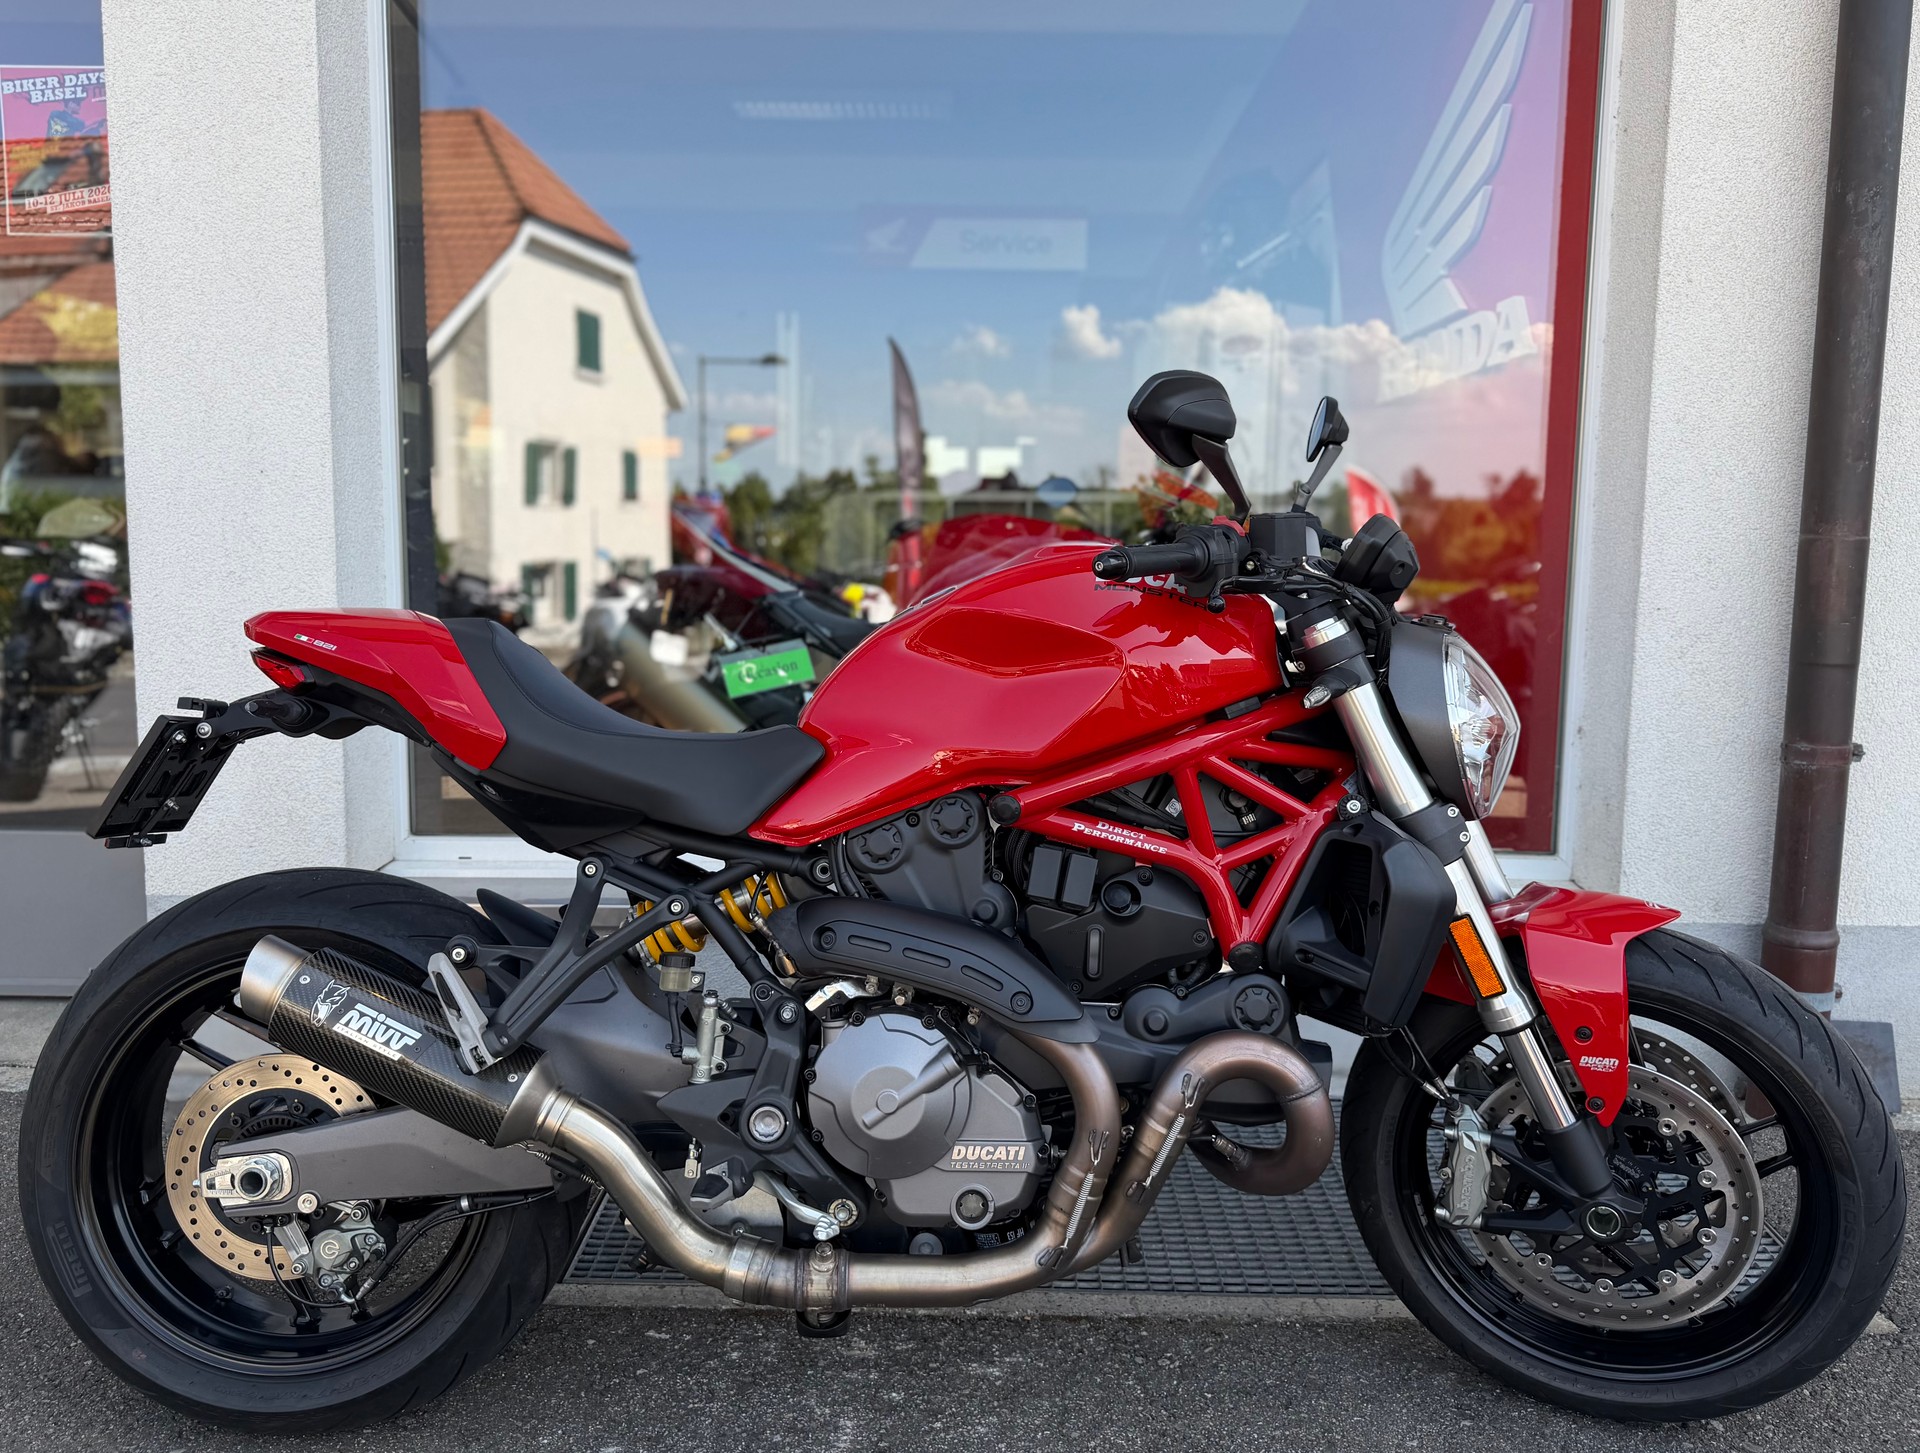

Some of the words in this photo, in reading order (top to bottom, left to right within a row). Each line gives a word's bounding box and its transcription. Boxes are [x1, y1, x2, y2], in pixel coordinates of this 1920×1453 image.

[2, 76, 60, 94] BIKER
[30, 87, 87, 103] BASEL
[27, 195, 55, 209] 10-12
[58, 190, 85, 206] JULI
[959, 228, 1054, 255] Service
[1071, 822, 1168, 855] PERFORMANCE
[1096, 821, 1147, 840] DIRECT
[1579, 1055, 1619, 1067] DUCATI
[951, 1145, 1026, 1161] DUCATI
[950, 1161, 1020, 1169] TESTASTRETTA
